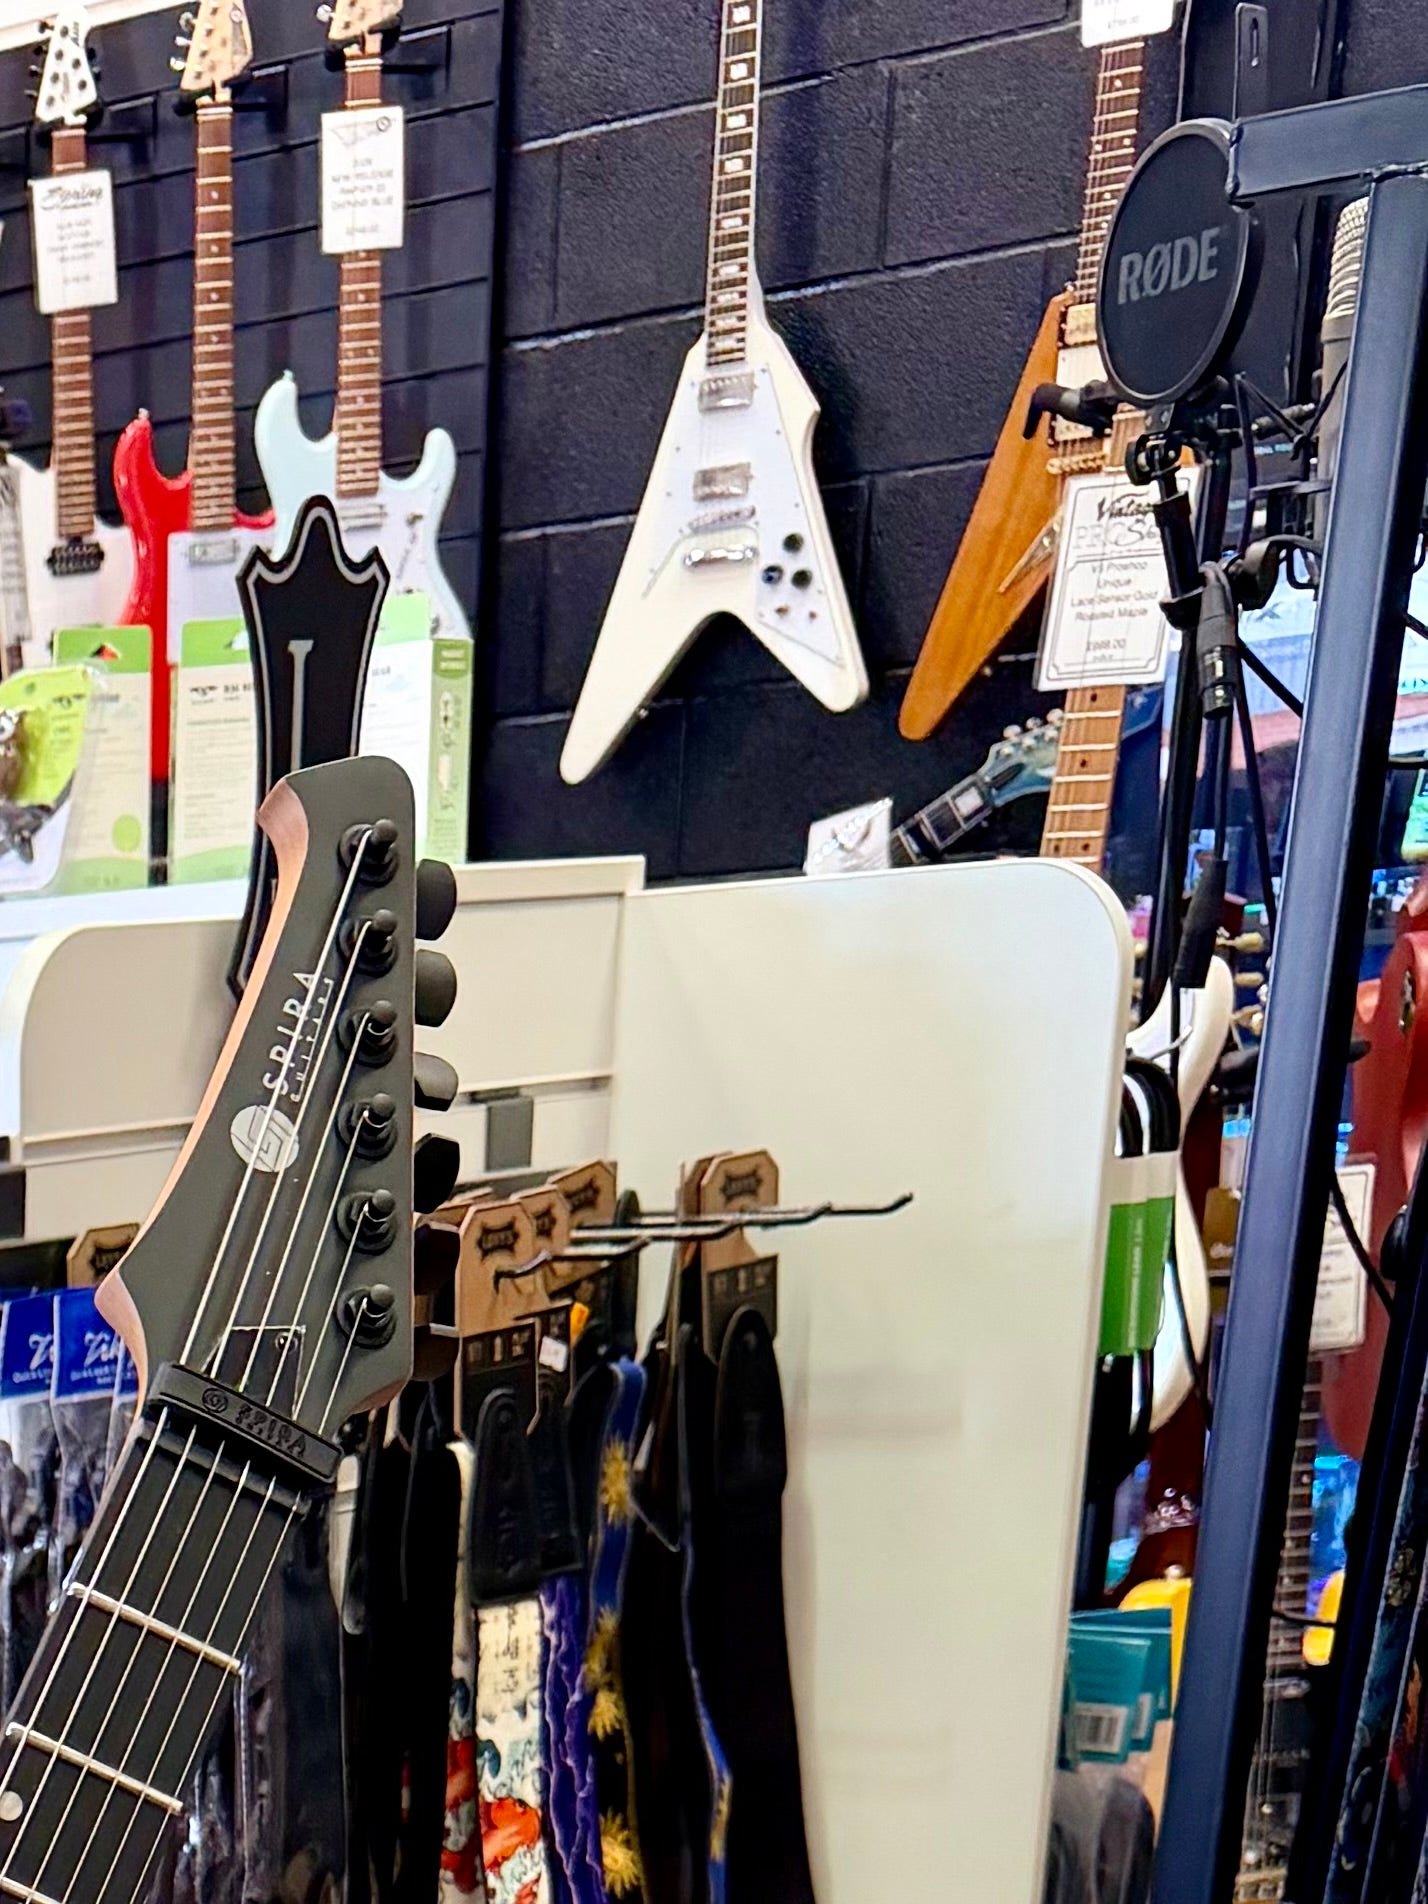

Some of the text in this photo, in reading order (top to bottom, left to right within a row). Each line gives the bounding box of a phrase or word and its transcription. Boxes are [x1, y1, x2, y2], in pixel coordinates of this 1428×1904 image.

[1118, 226, 1221, 305] RØDE
[262, 972, 318, 1096] SPIRA
[235, 1404, 307, 1459] SPIRA
